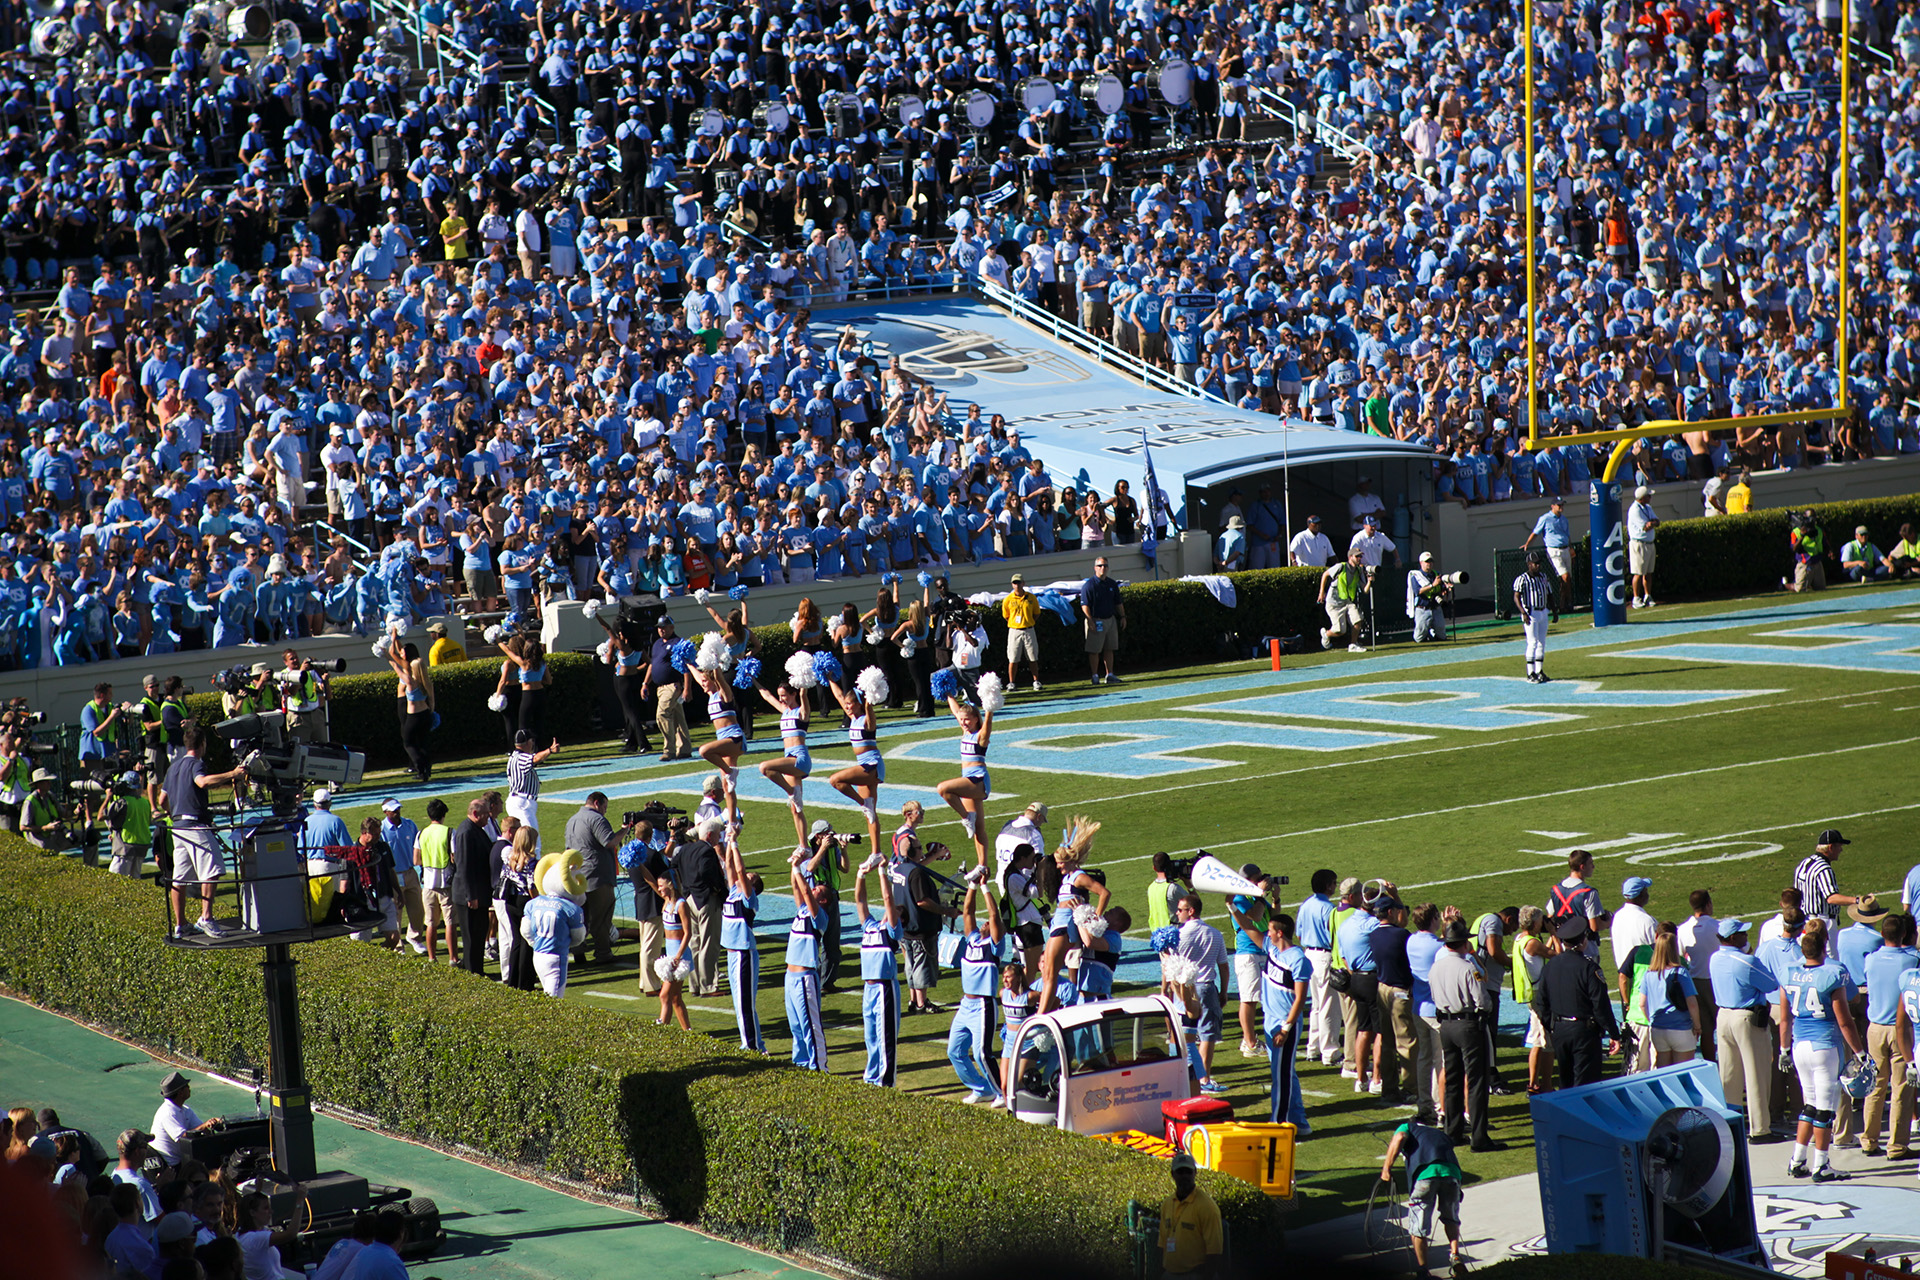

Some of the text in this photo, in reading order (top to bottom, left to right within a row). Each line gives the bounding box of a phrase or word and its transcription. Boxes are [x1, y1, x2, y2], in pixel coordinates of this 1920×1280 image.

[1603, 521, 1625, 606] ACC
[1792, 972, 1814, 983] ELLIS
[1785, 984, 1826, 1018] 74
[1113, 1082, 1159, 1104] Sports
[1113, 1090, 1173, 1107] Medicine
